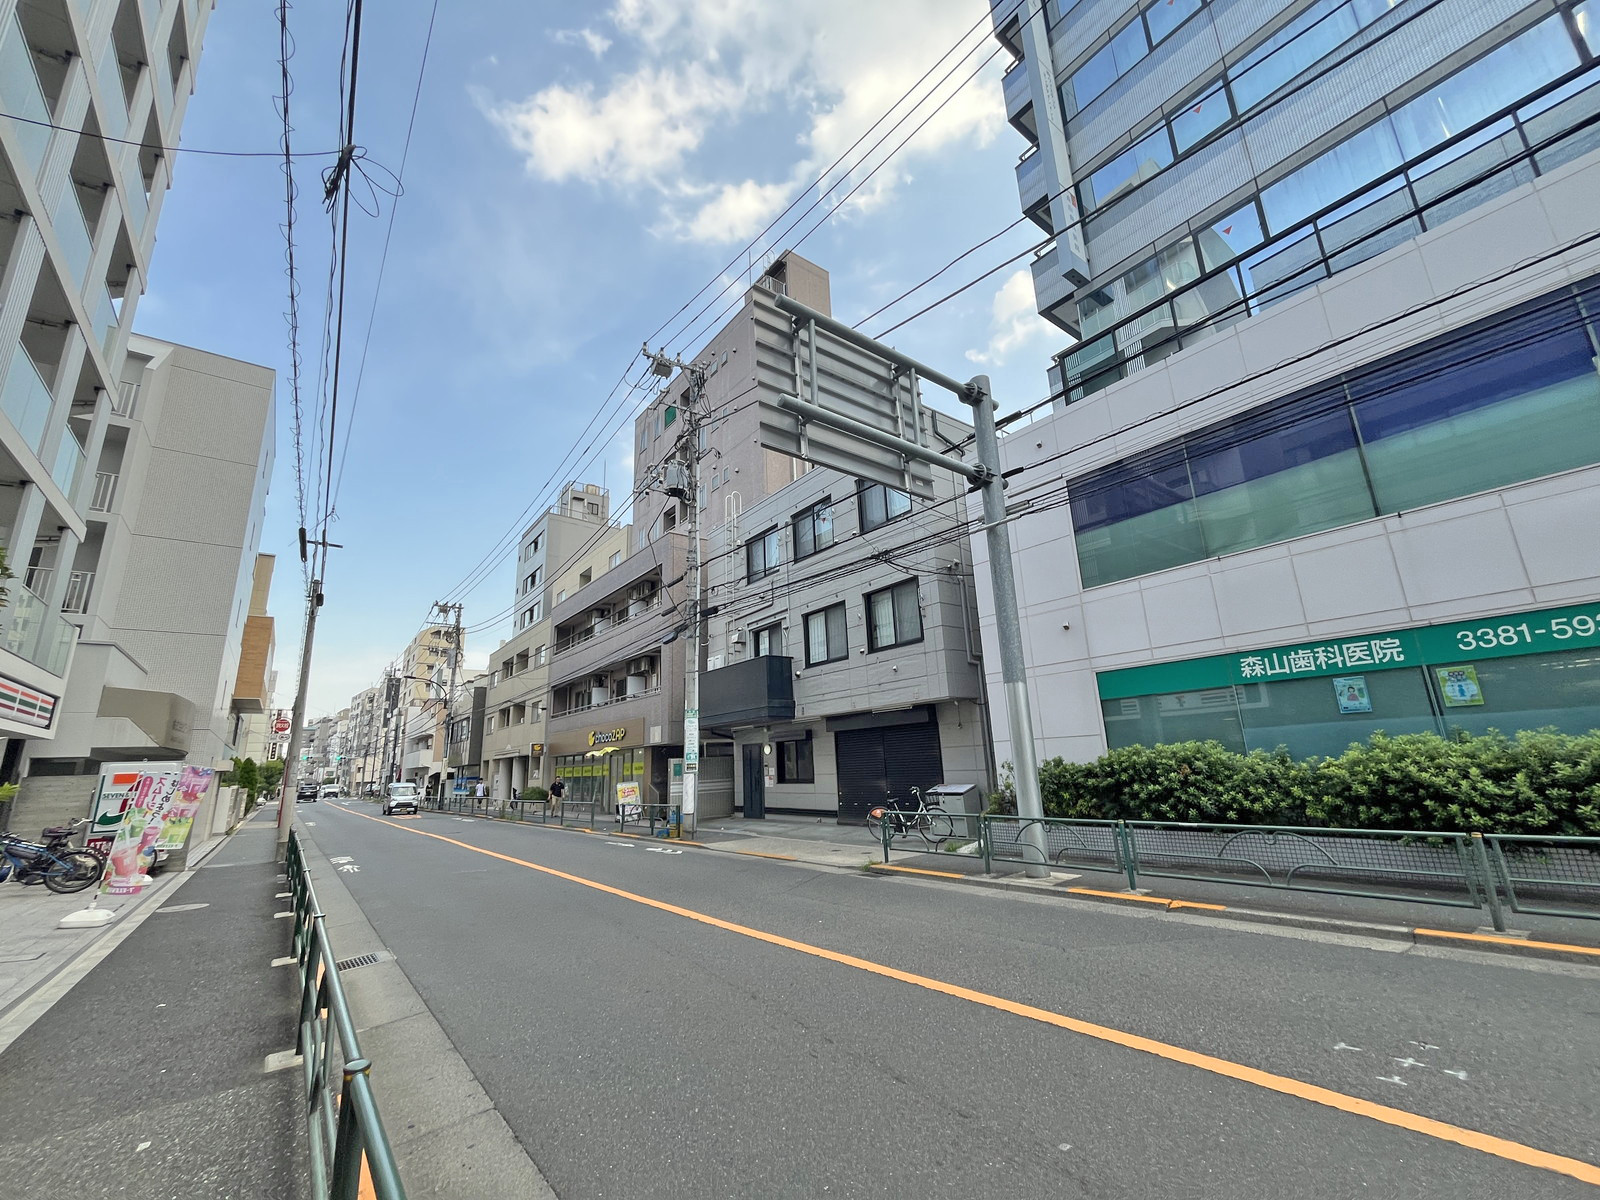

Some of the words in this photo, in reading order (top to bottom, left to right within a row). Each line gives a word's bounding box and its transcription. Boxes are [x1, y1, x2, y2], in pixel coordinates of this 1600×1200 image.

[1456, 615, 1600, 651] 3381-59
[1240, 638, 1405, 678] 森山歯科医院
